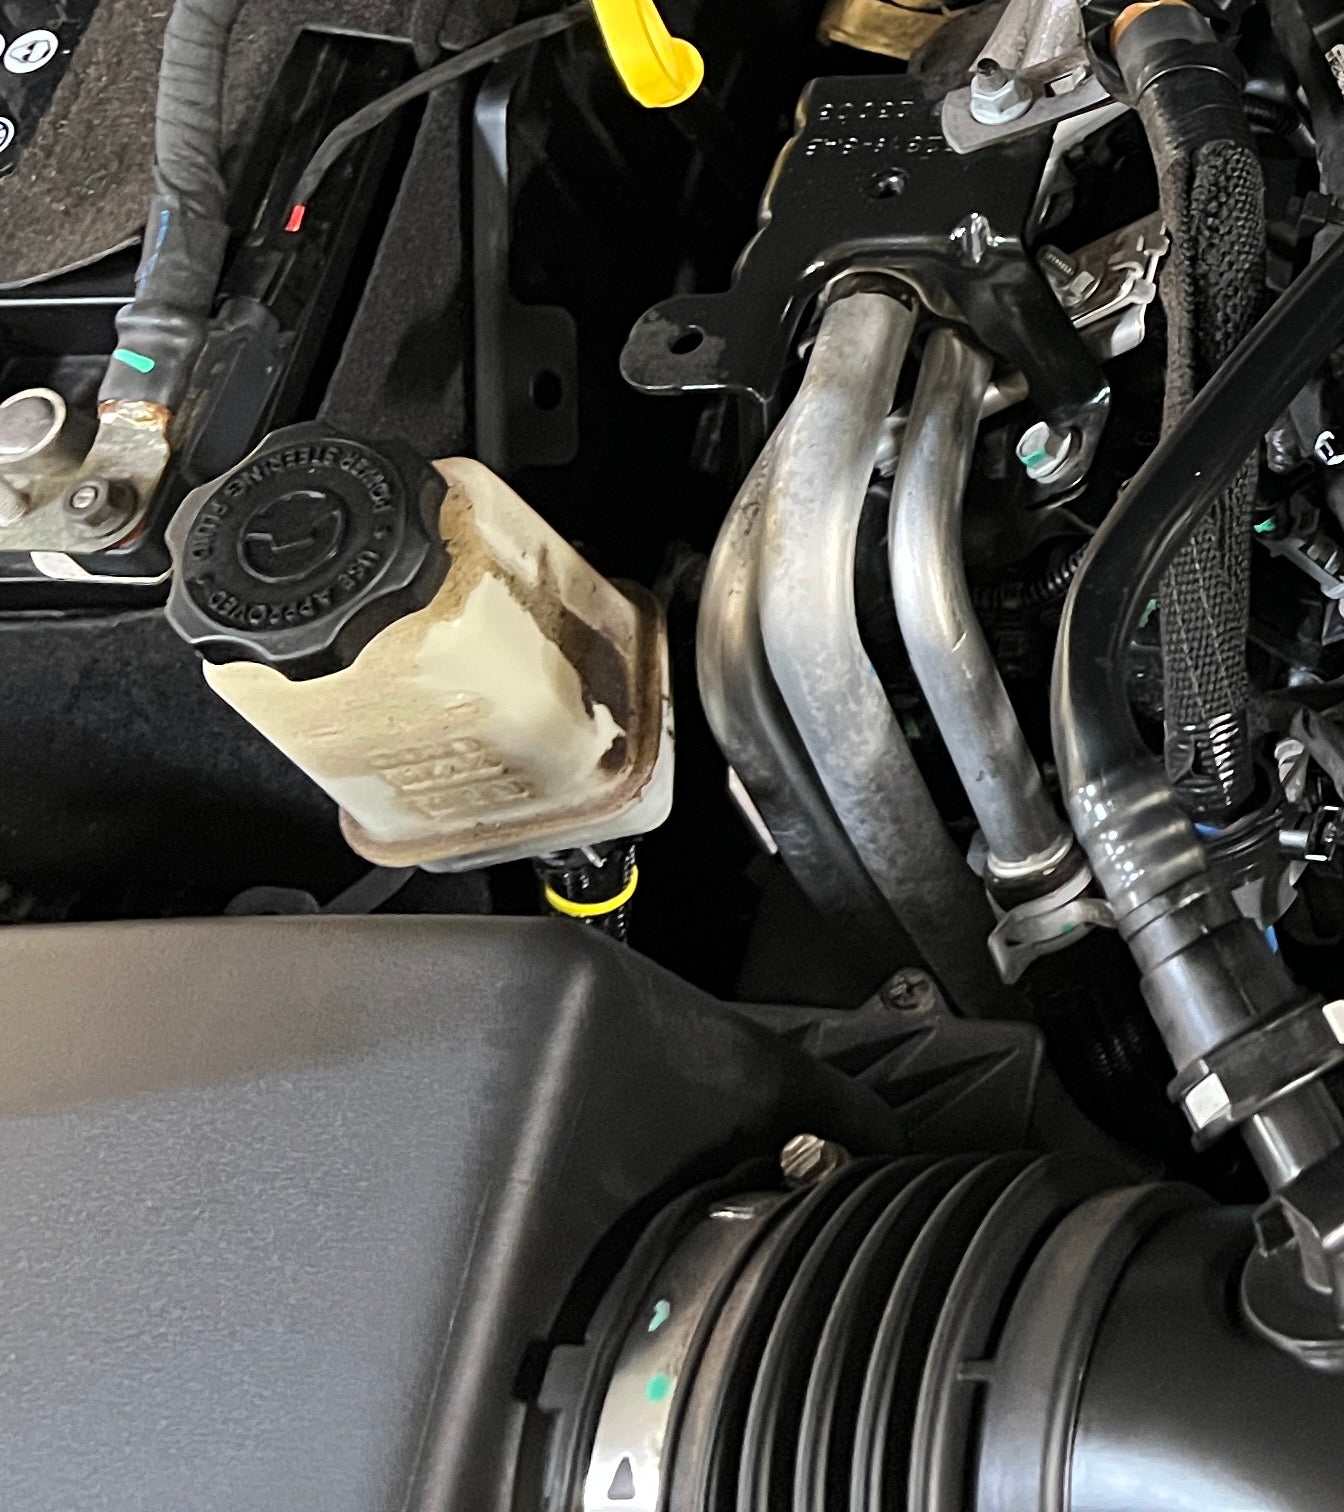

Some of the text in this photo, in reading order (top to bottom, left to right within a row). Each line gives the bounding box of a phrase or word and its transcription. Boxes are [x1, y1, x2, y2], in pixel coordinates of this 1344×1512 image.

[192, 446, 393, 560] POWER STEERING FLUID
[208, 550, 381, 625] USE APPROVED
